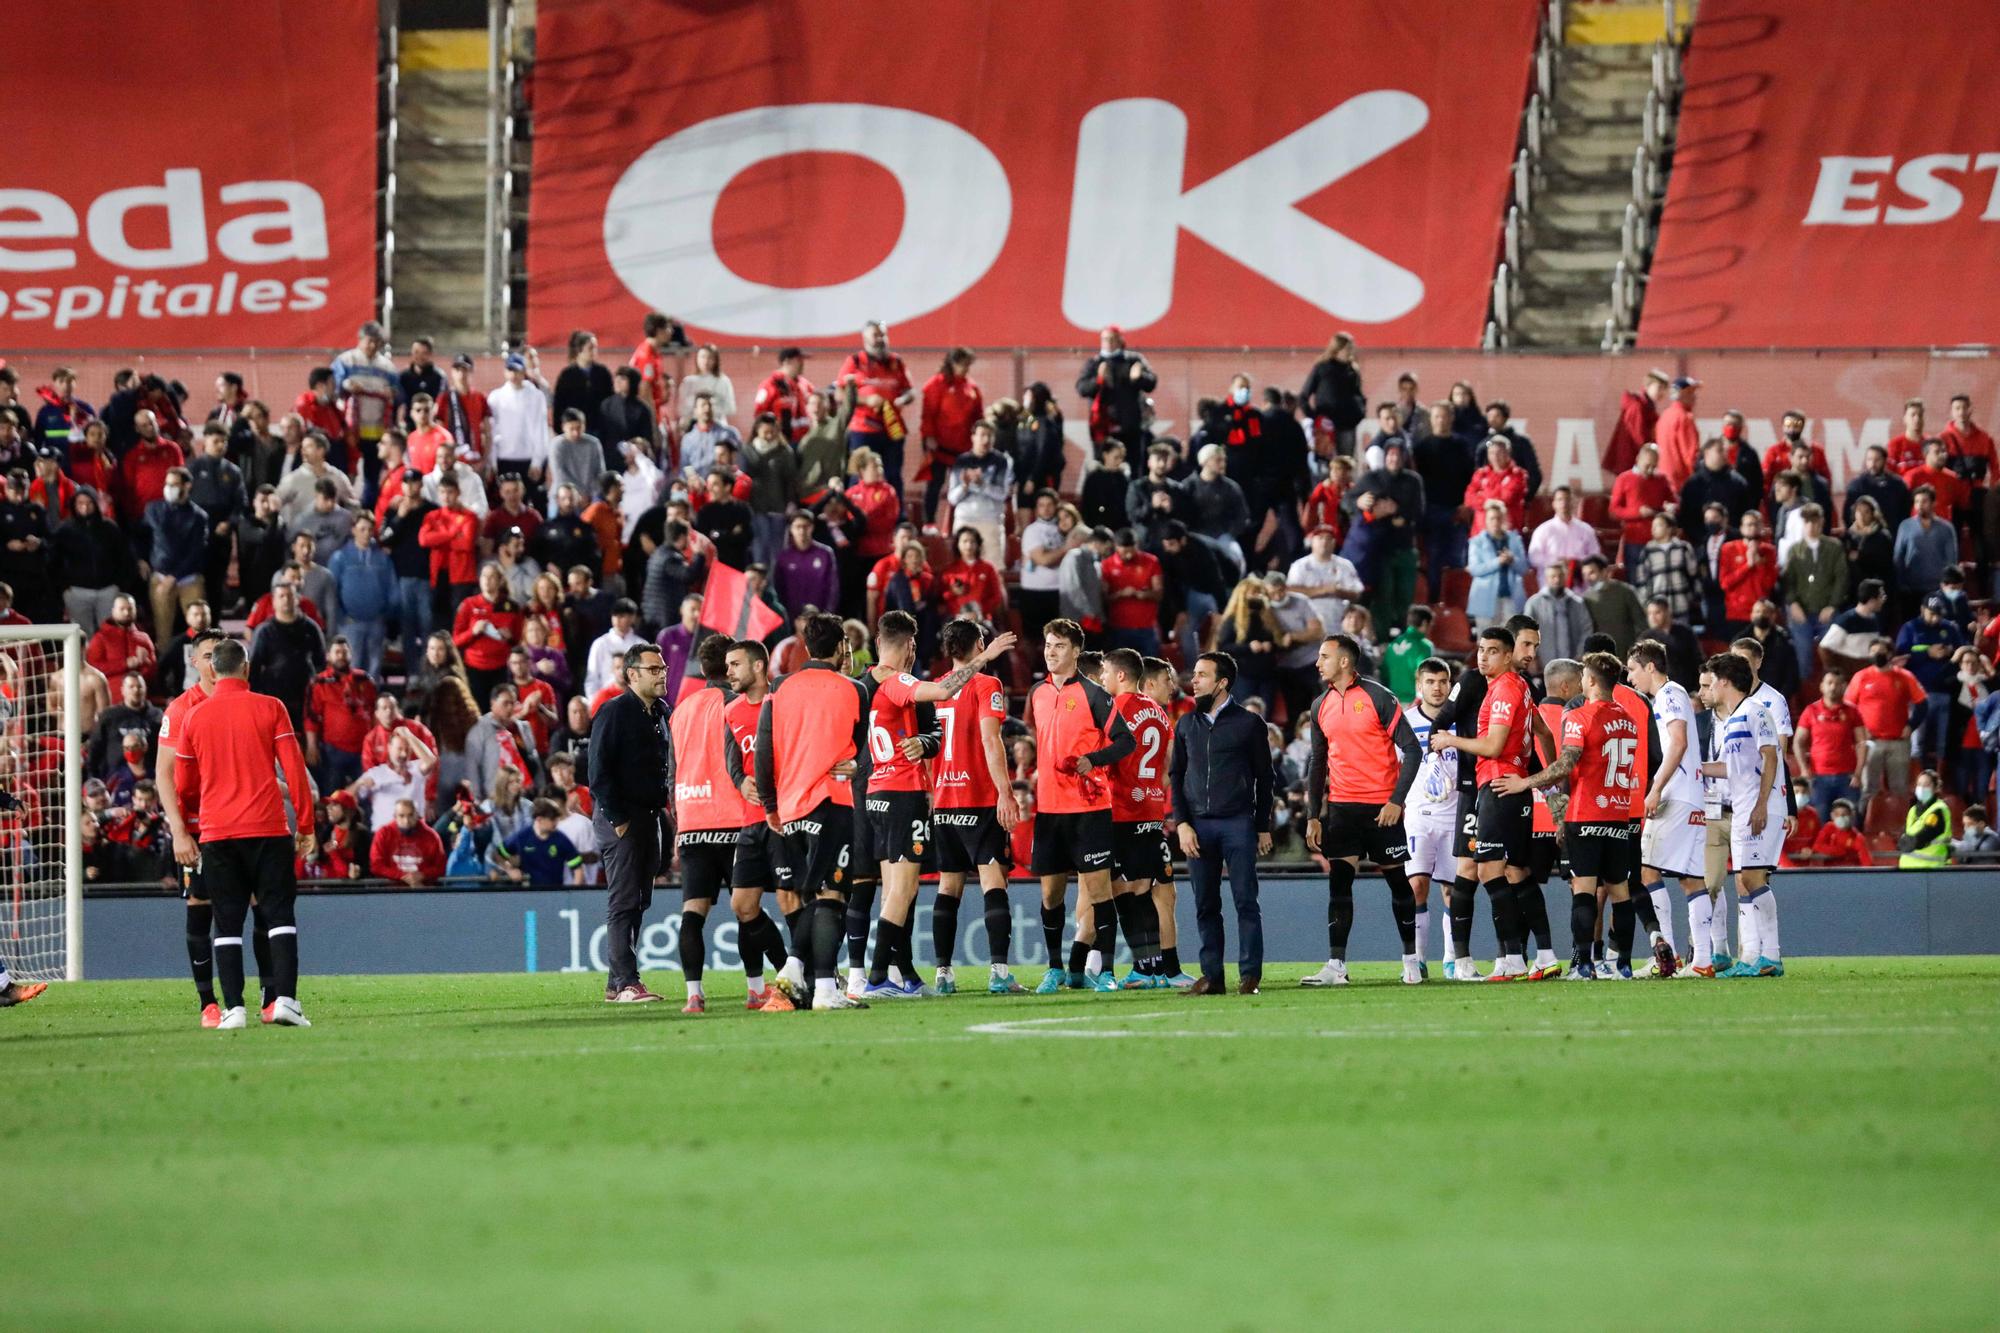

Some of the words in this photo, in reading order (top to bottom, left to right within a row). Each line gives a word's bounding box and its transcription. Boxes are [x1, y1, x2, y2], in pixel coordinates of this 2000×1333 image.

[603, 90, 1430, 337] OK
[0, 272, 329, 329] spitales
[1492, 701, 1512, 714] OK
[867, 709, 895, 763] 6
[1137, 726, 1160, 779] 2
[1601, 738, 1638, 788] 15
[911, 819, 931, 842] 26
[1463, 813, 1478, 836] 2
[837, 844, 849, 868] 6
[1409, 836, 1416, 853] 1
